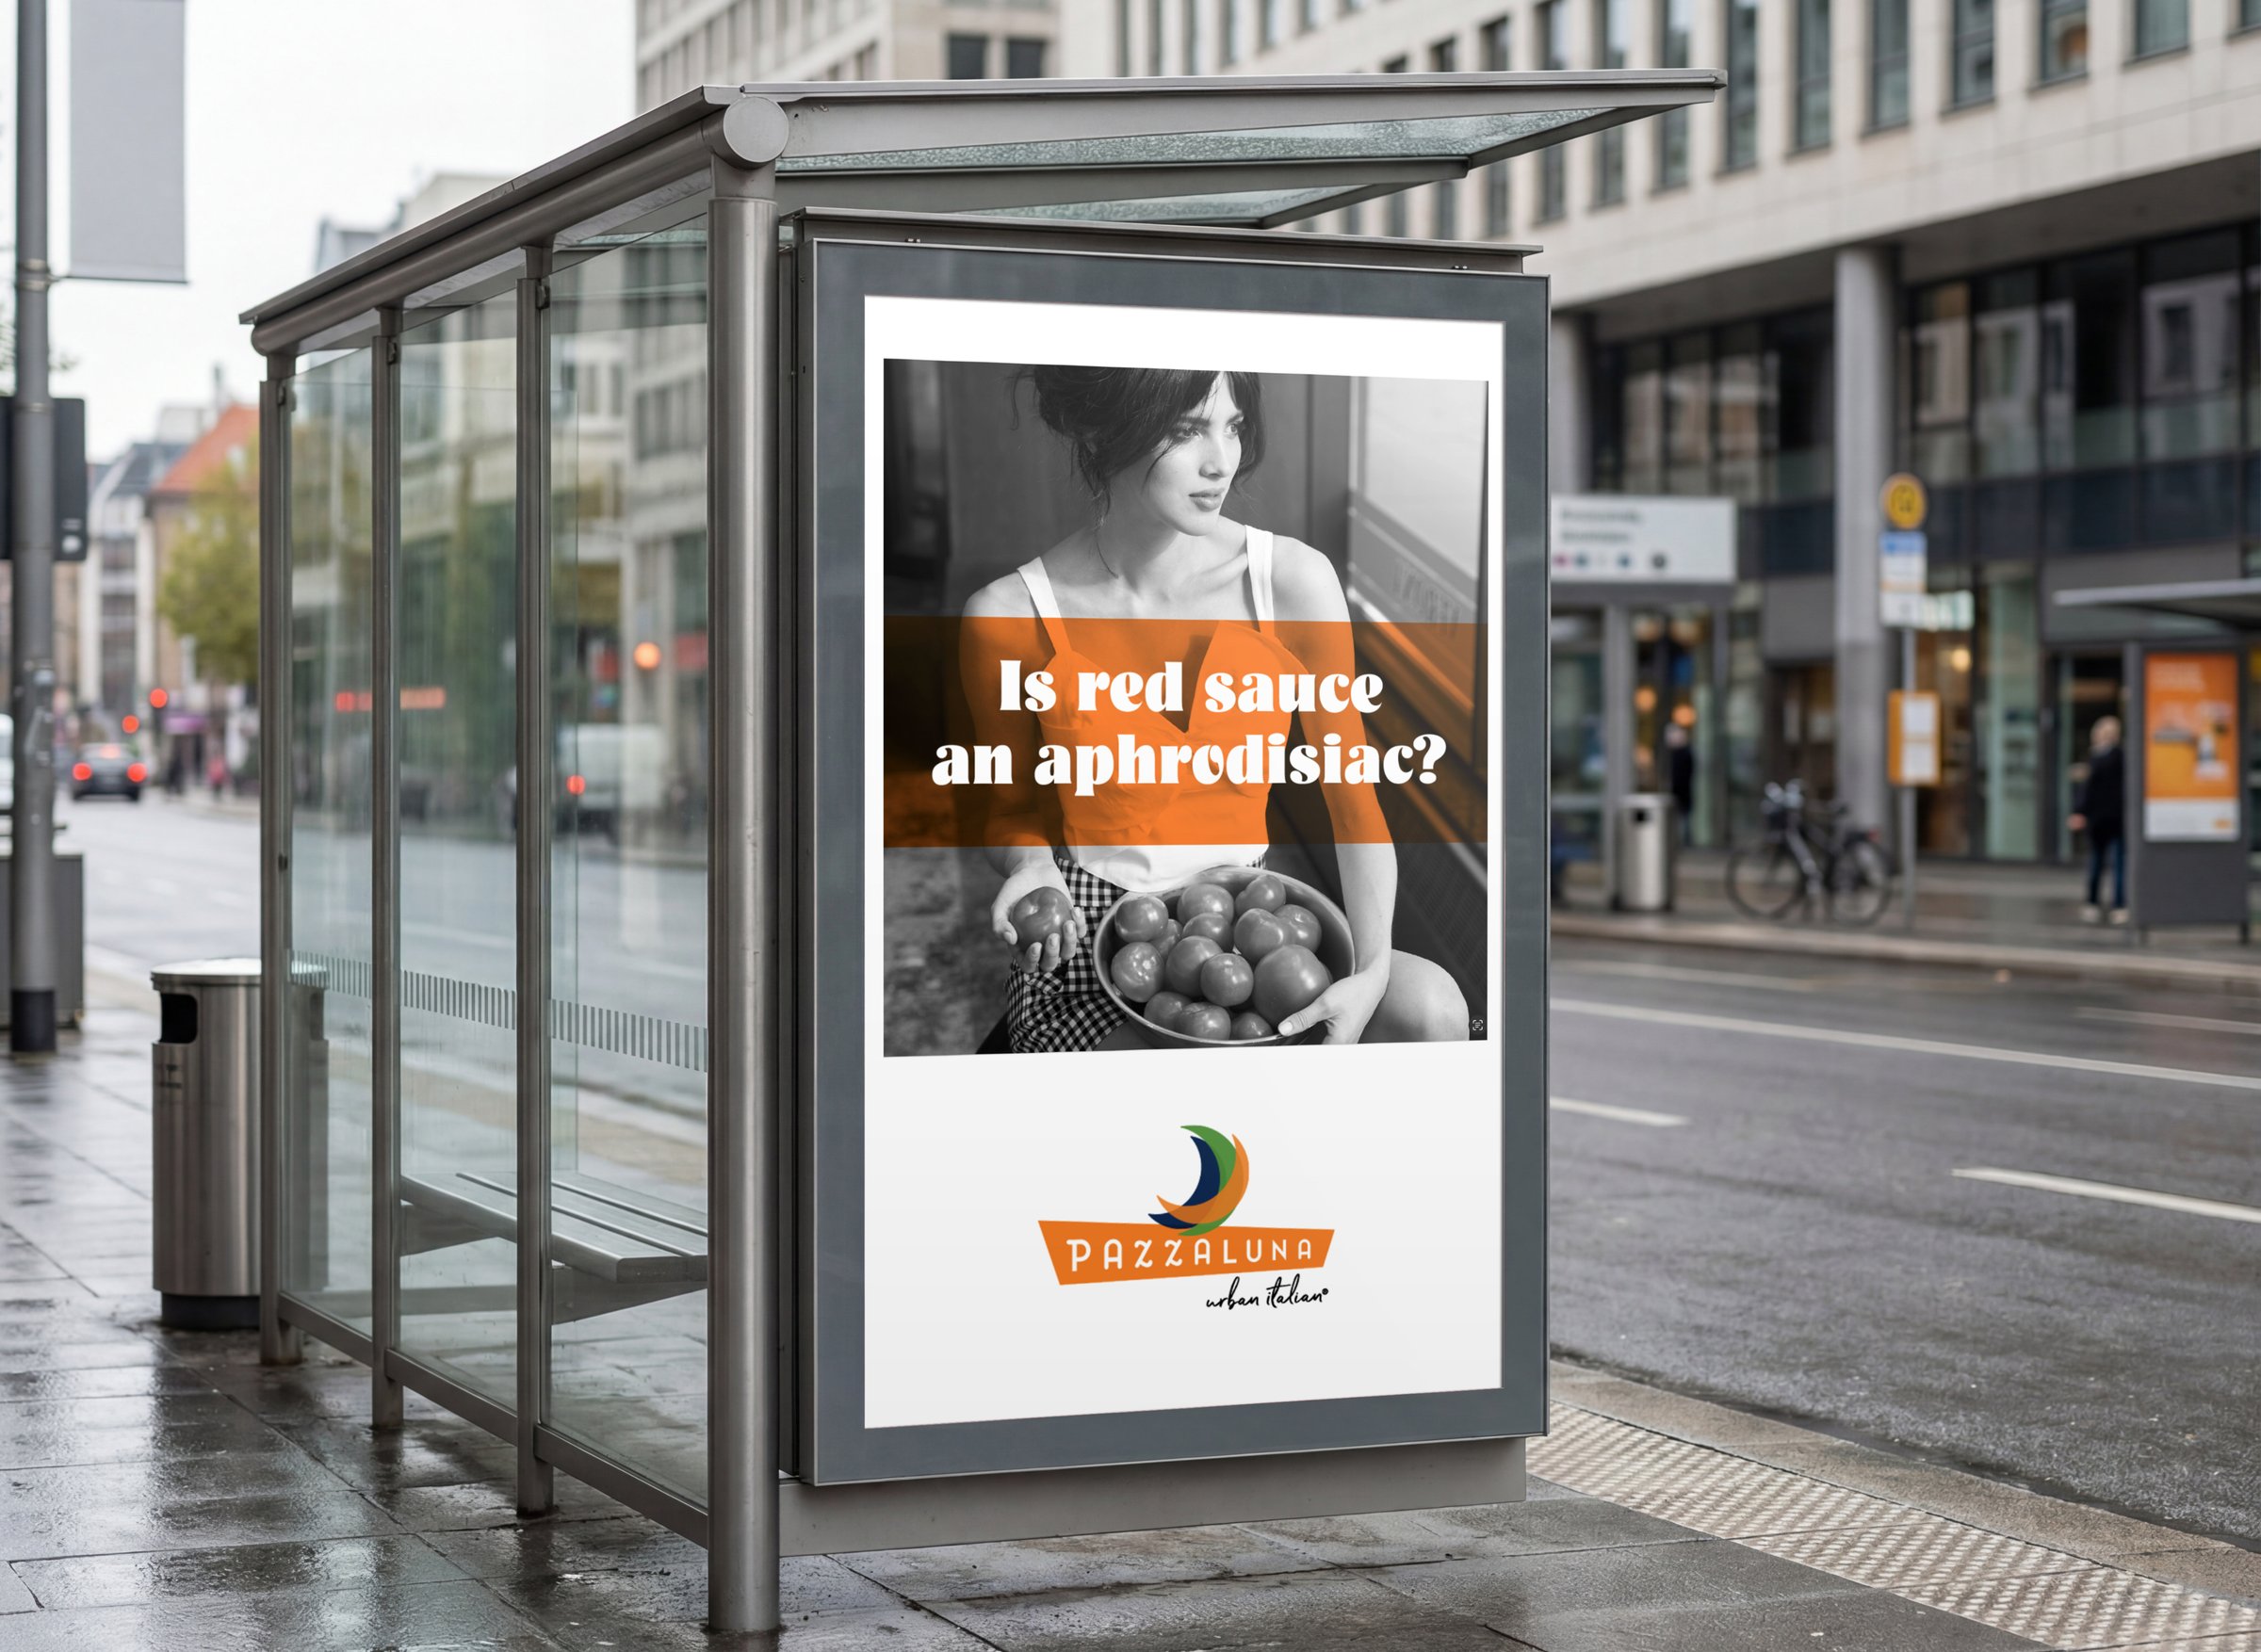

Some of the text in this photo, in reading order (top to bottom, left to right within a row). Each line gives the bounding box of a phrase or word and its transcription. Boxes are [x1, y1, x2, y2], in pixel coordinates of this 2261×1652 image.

[1000, 659, 1384, 714] Is red sauce
[932, 733, 1447, 797] an aphrodisiac?
[1065, 1238, 1312, 1272] PAZZALUNA
[1206, 1275, 1260, 1310] urban
